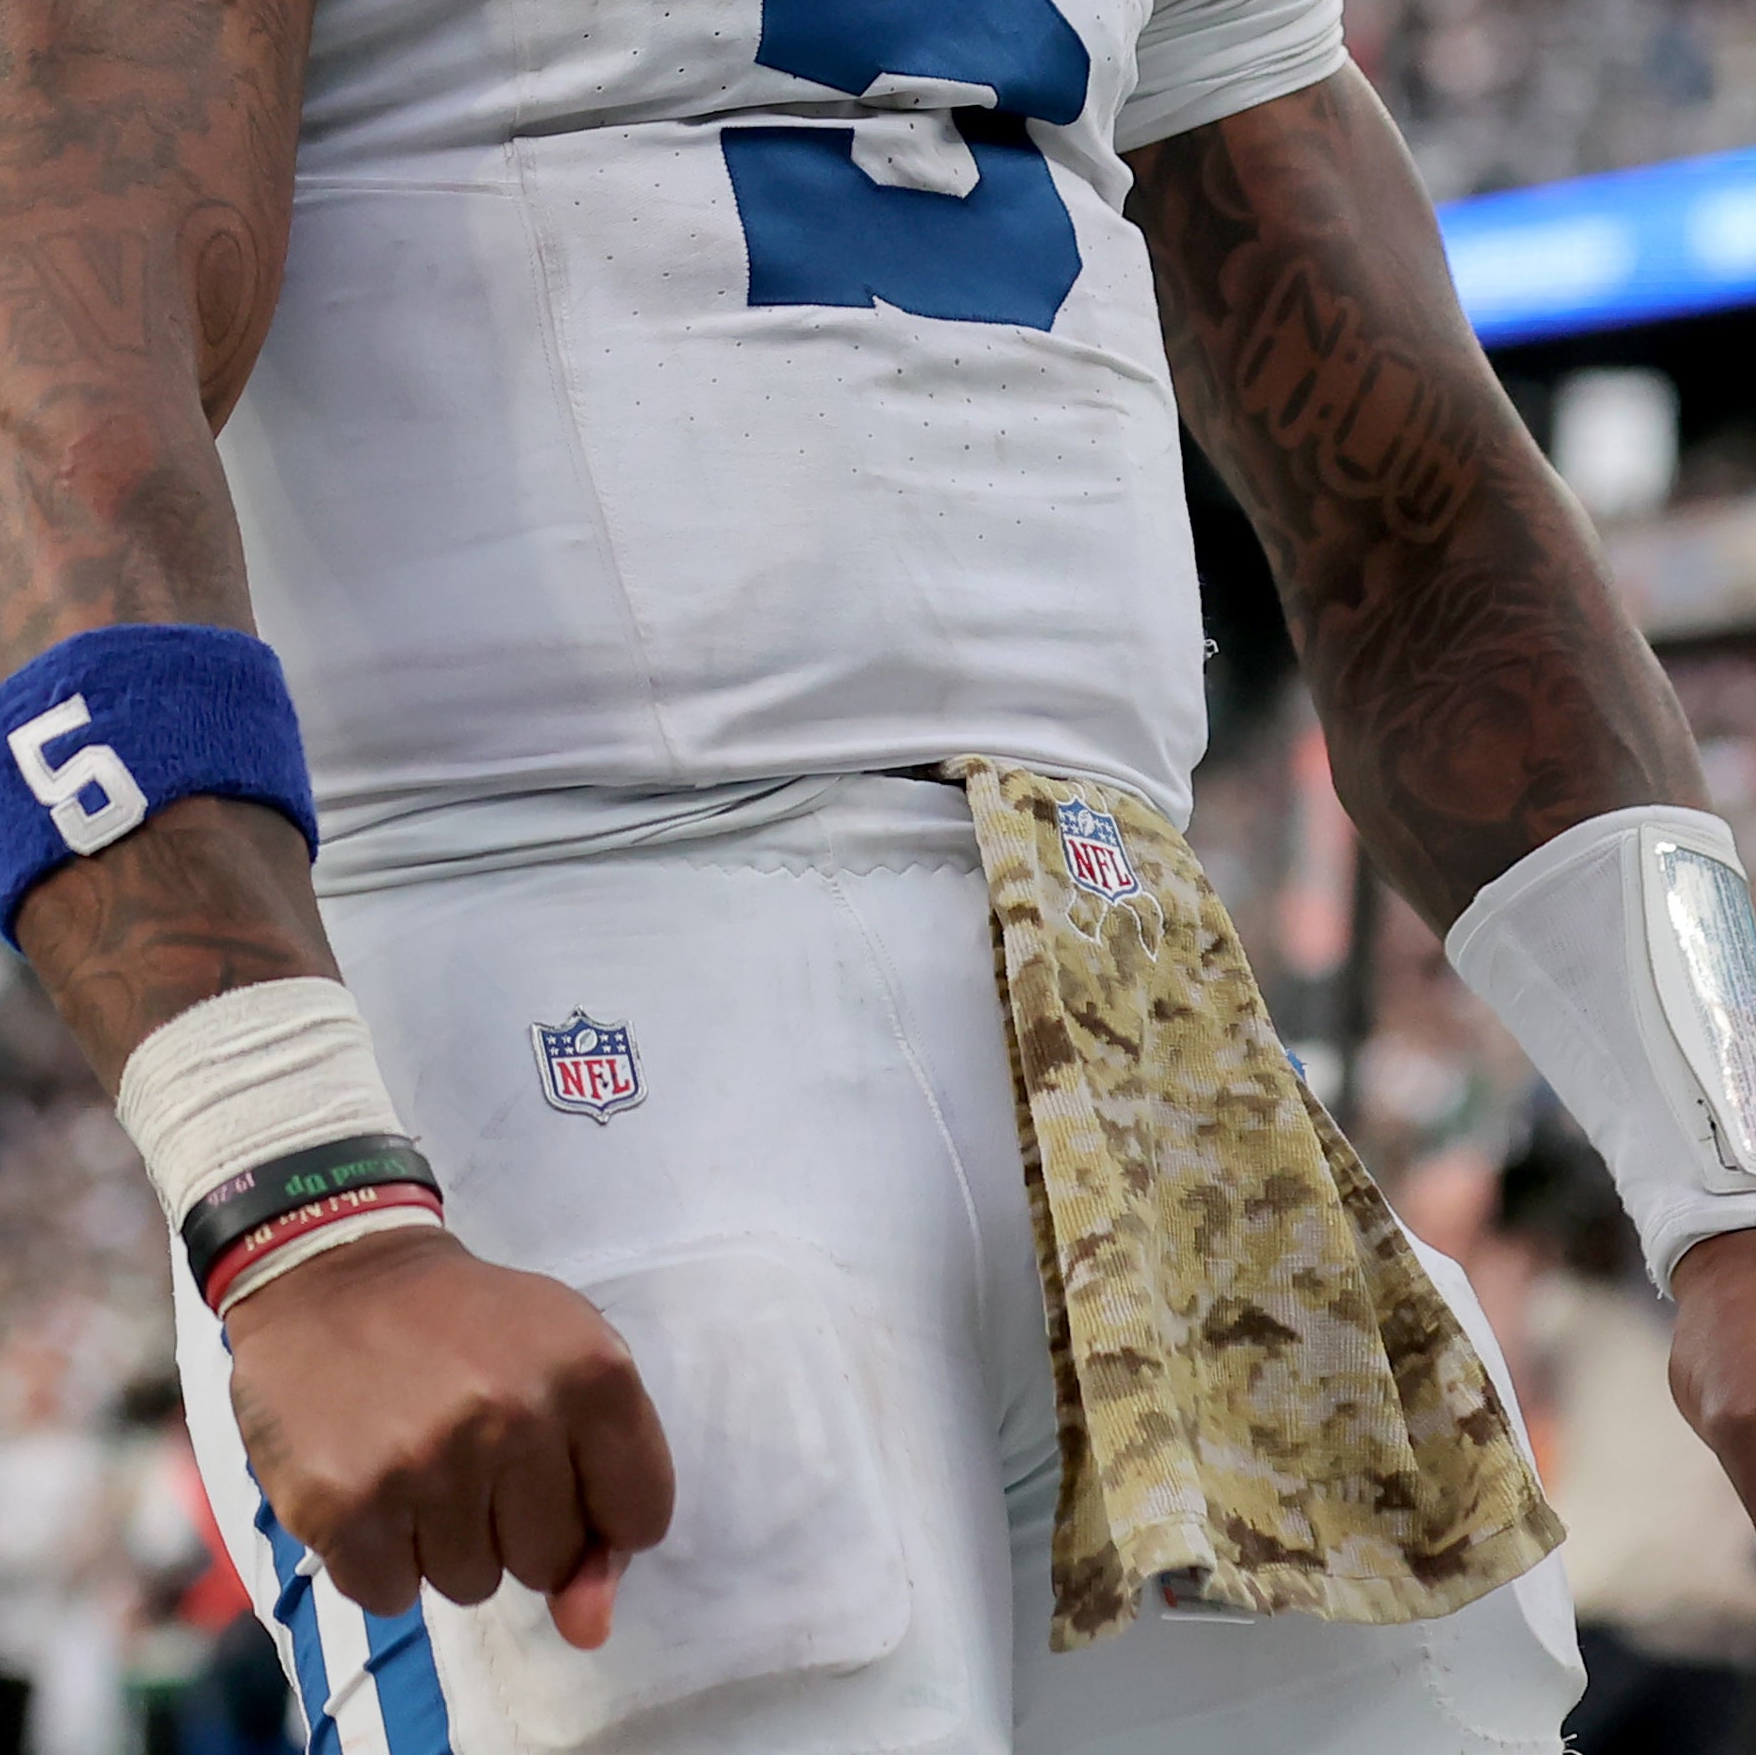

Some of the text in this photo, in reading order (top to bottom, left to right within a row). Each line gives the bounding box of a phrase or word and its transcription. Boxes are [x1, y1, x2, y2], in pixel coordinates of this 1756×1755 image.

[6, 692, 150, 857] 5
[1067, 838, 1133, 891] NFL
[555, 1058, 631, 1102] NFL
[283, 1172, 327, 1197] Up
